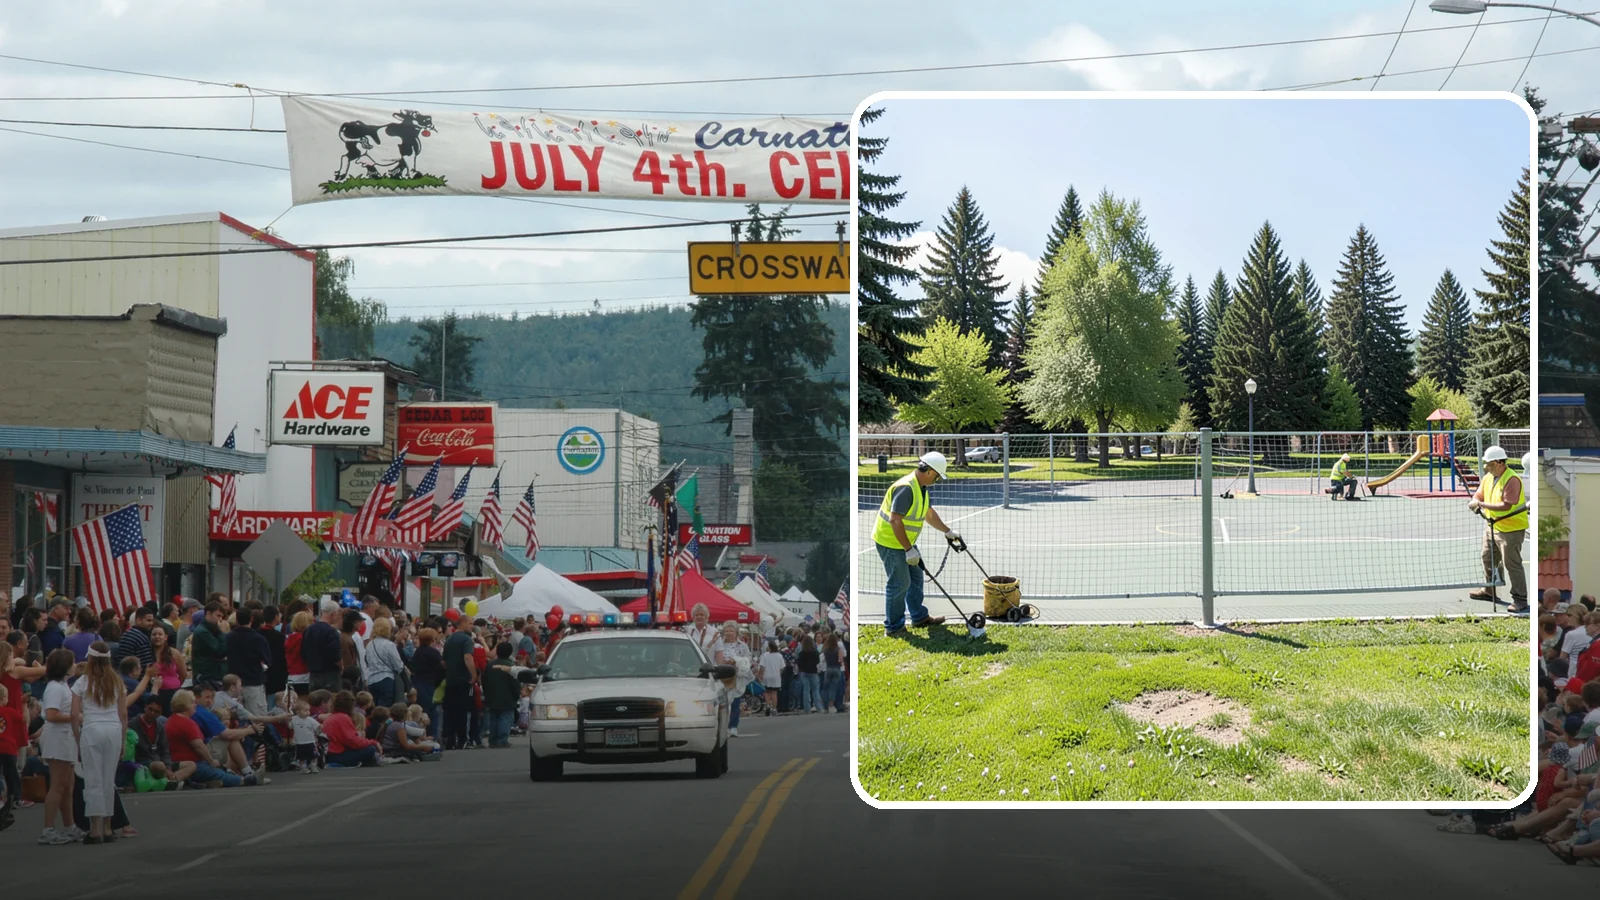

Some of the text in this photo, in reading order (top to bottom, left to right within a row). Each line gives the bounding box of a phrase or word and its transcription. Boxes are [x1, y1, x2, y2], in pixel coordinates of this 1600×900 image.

[694, 121, 851, 150] Carnat
[481, 140, 605, 192] JULY
[632, 149, 747, 197] 4th.
[696, 254, 850, 280] CROSSWA
[282, 380, 374, 420] ACE
[405, 408, 453, 422] CEDAR
[283, 420, 371, 436] Hardware
[96, 485, 124, 495] Vincent
[126, 486, 136, 495] de
[138, 486, 155, 495] Paul
[688, 526, 741, 535] CRNATION
[699, 535, 730, 543] GLASS
